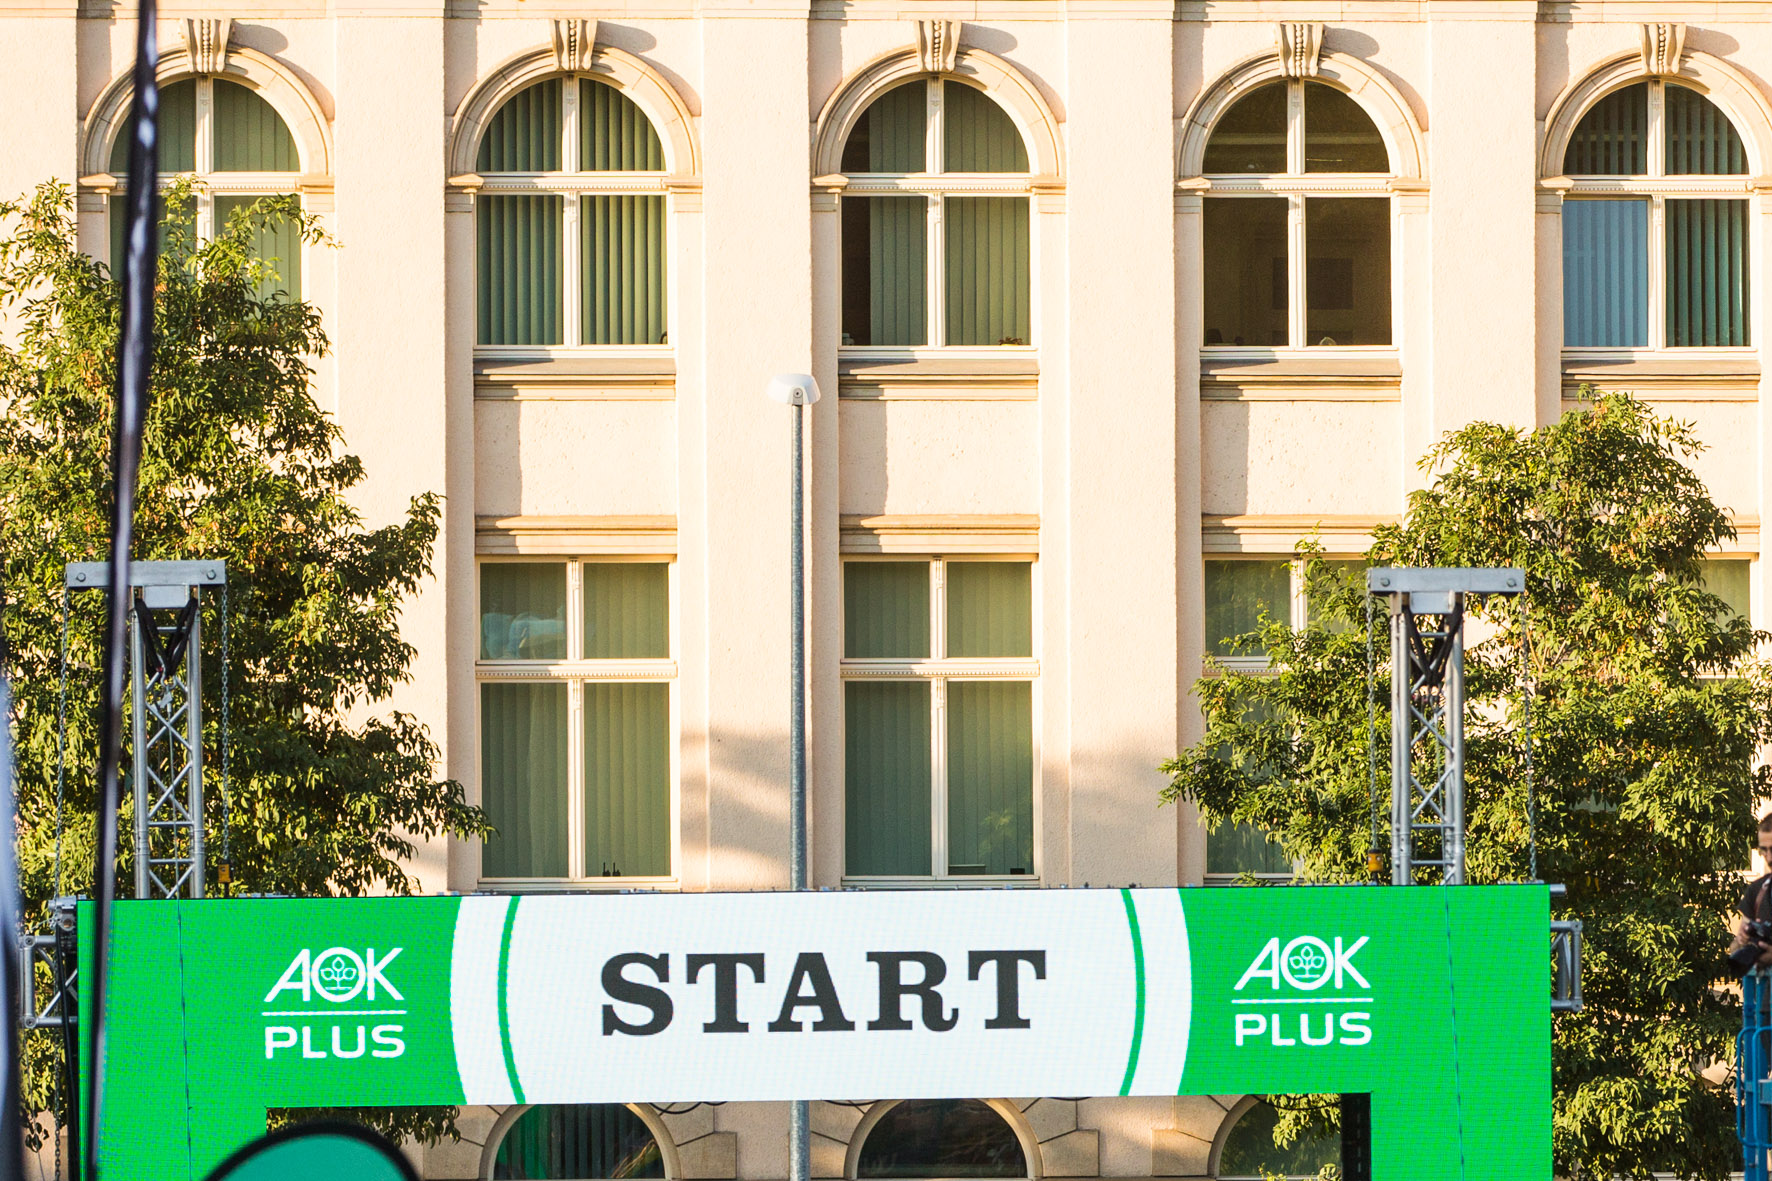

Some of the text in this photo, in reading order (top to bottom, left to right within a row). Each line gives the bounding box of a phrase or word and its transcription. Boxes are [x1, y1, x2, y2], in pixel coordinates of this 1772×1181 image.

[264, 946, 404, 1002] AOK
[1234, 935, 1371, 991] AOK
[600, 950, 1047, 1037] START
[265, 1024, 405, 1059] PLUS
[1235, 1012, 1372, 1046] PLUS
